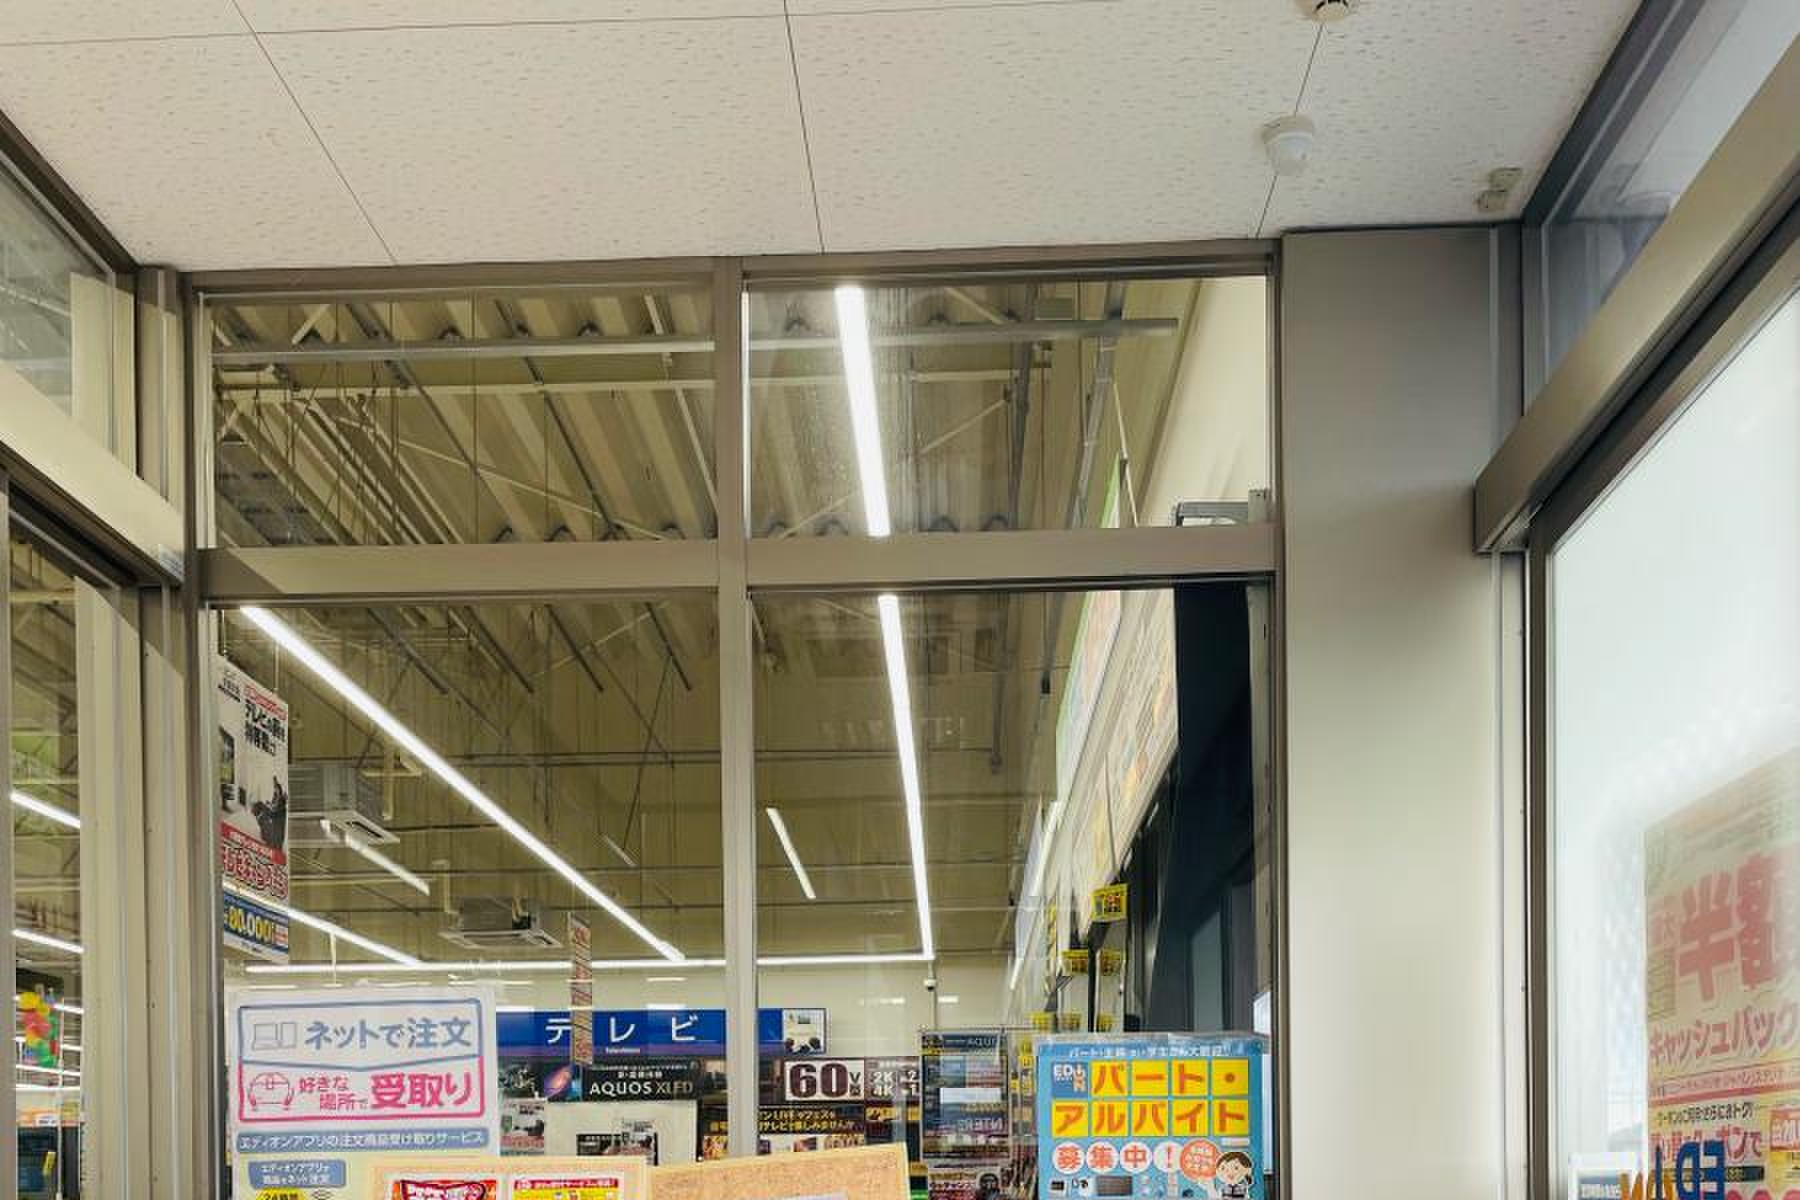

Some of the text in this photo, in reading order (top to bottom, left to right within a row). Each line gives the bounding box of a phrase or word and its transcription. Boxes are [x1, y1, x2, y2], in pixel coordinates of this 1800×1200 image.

[305, 1016, 472, 1050] ネットで注文
[545, 1014, 698, 1044] テレビ
[371, 1071, 472, 1109] 受取り
[589, 1081, 652, 1097] AQUOS
[1055, 1103, 1245, 1134] アルバイト
